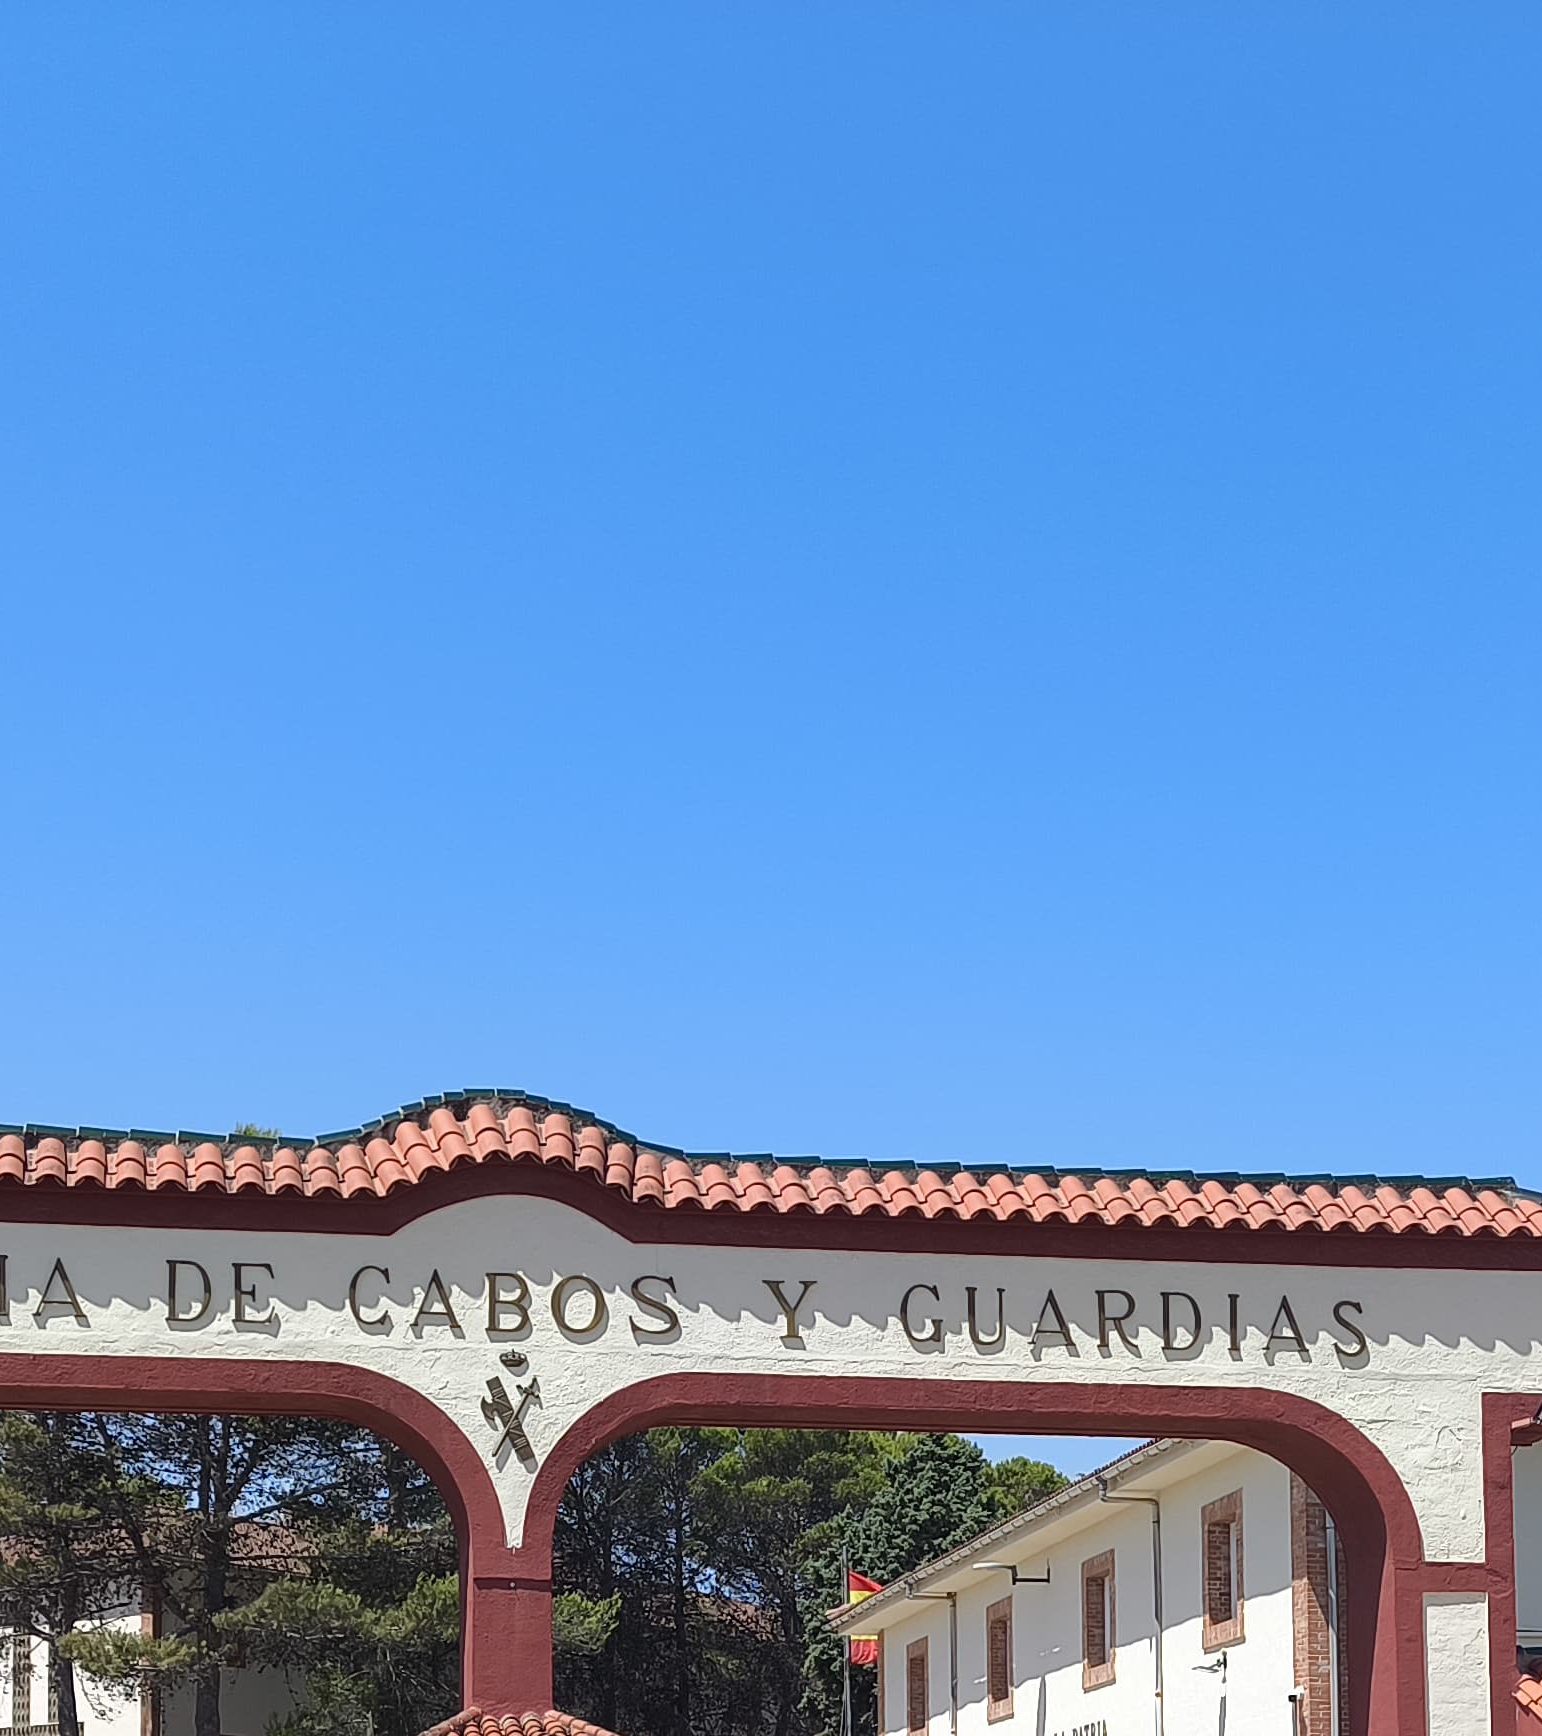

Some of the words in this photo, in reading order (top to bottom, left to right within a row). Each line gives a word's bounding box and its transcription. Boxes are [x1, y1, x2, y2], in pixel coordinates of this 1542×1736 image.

[165, 1259, 278, 1325] DE
[348, 1264, 679, 1336] CABOS
[762, 1279, 818, 1340] Y
[899, 1283, 1366, 1358] GUARDIAS
